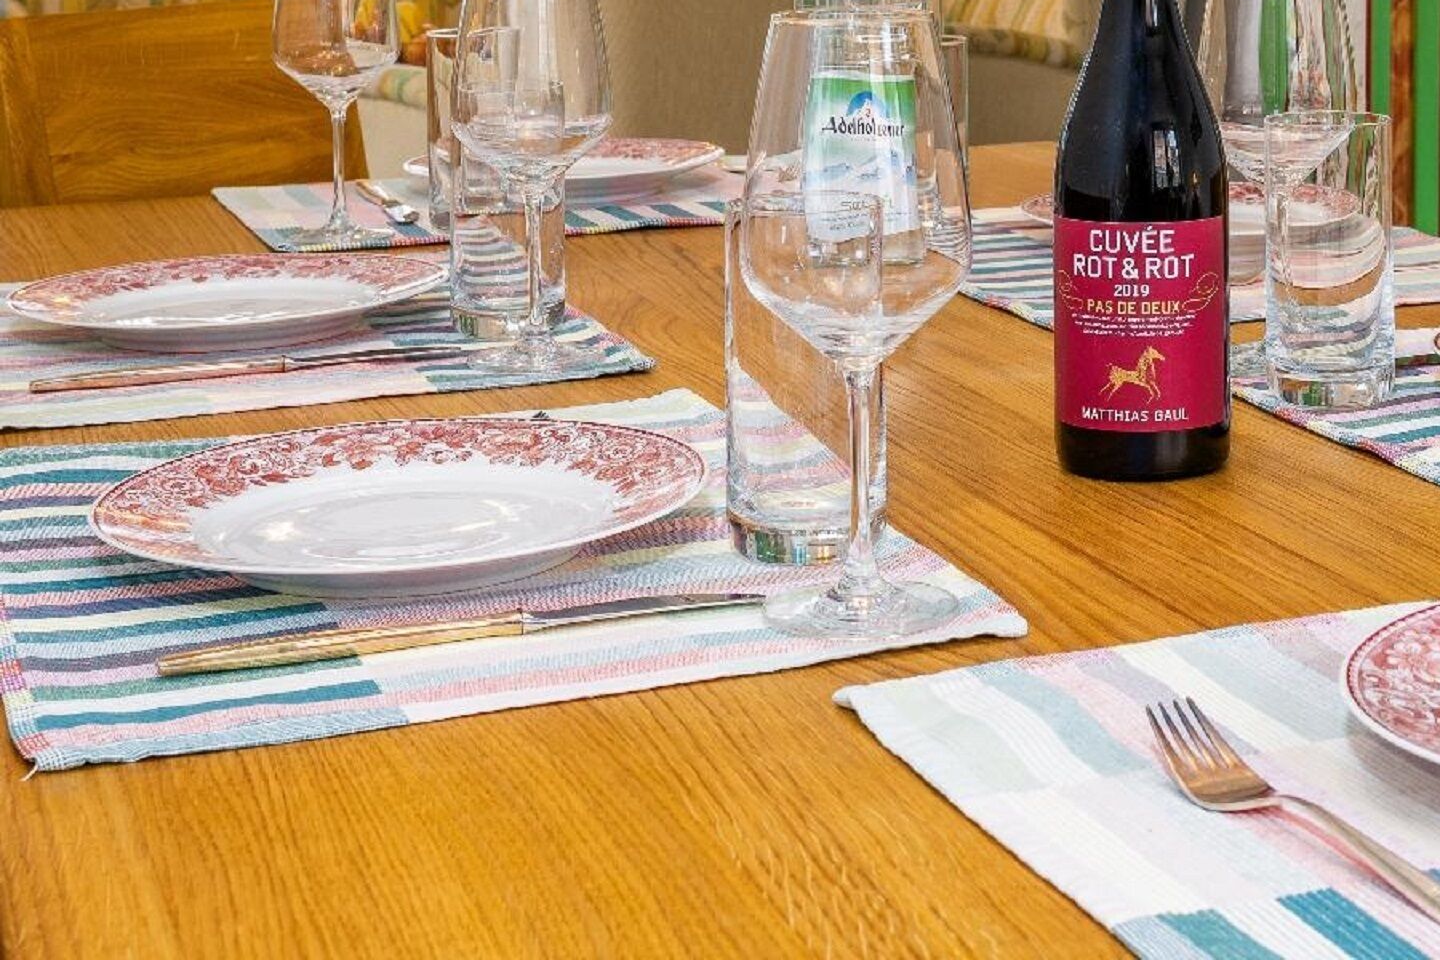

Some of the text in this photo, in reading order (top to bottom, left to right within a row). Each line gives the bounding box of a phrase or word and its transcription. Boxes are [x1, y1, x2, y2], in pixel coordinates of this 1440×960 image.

[1090, 225, 1175, 253] CUVÉE
[1113, 284, 1150, 297] 2019
[1087, 298, 1180, 315] PAS DE DEUX
[1082, 405, 1189, 422] MATTHIAS GAUL
